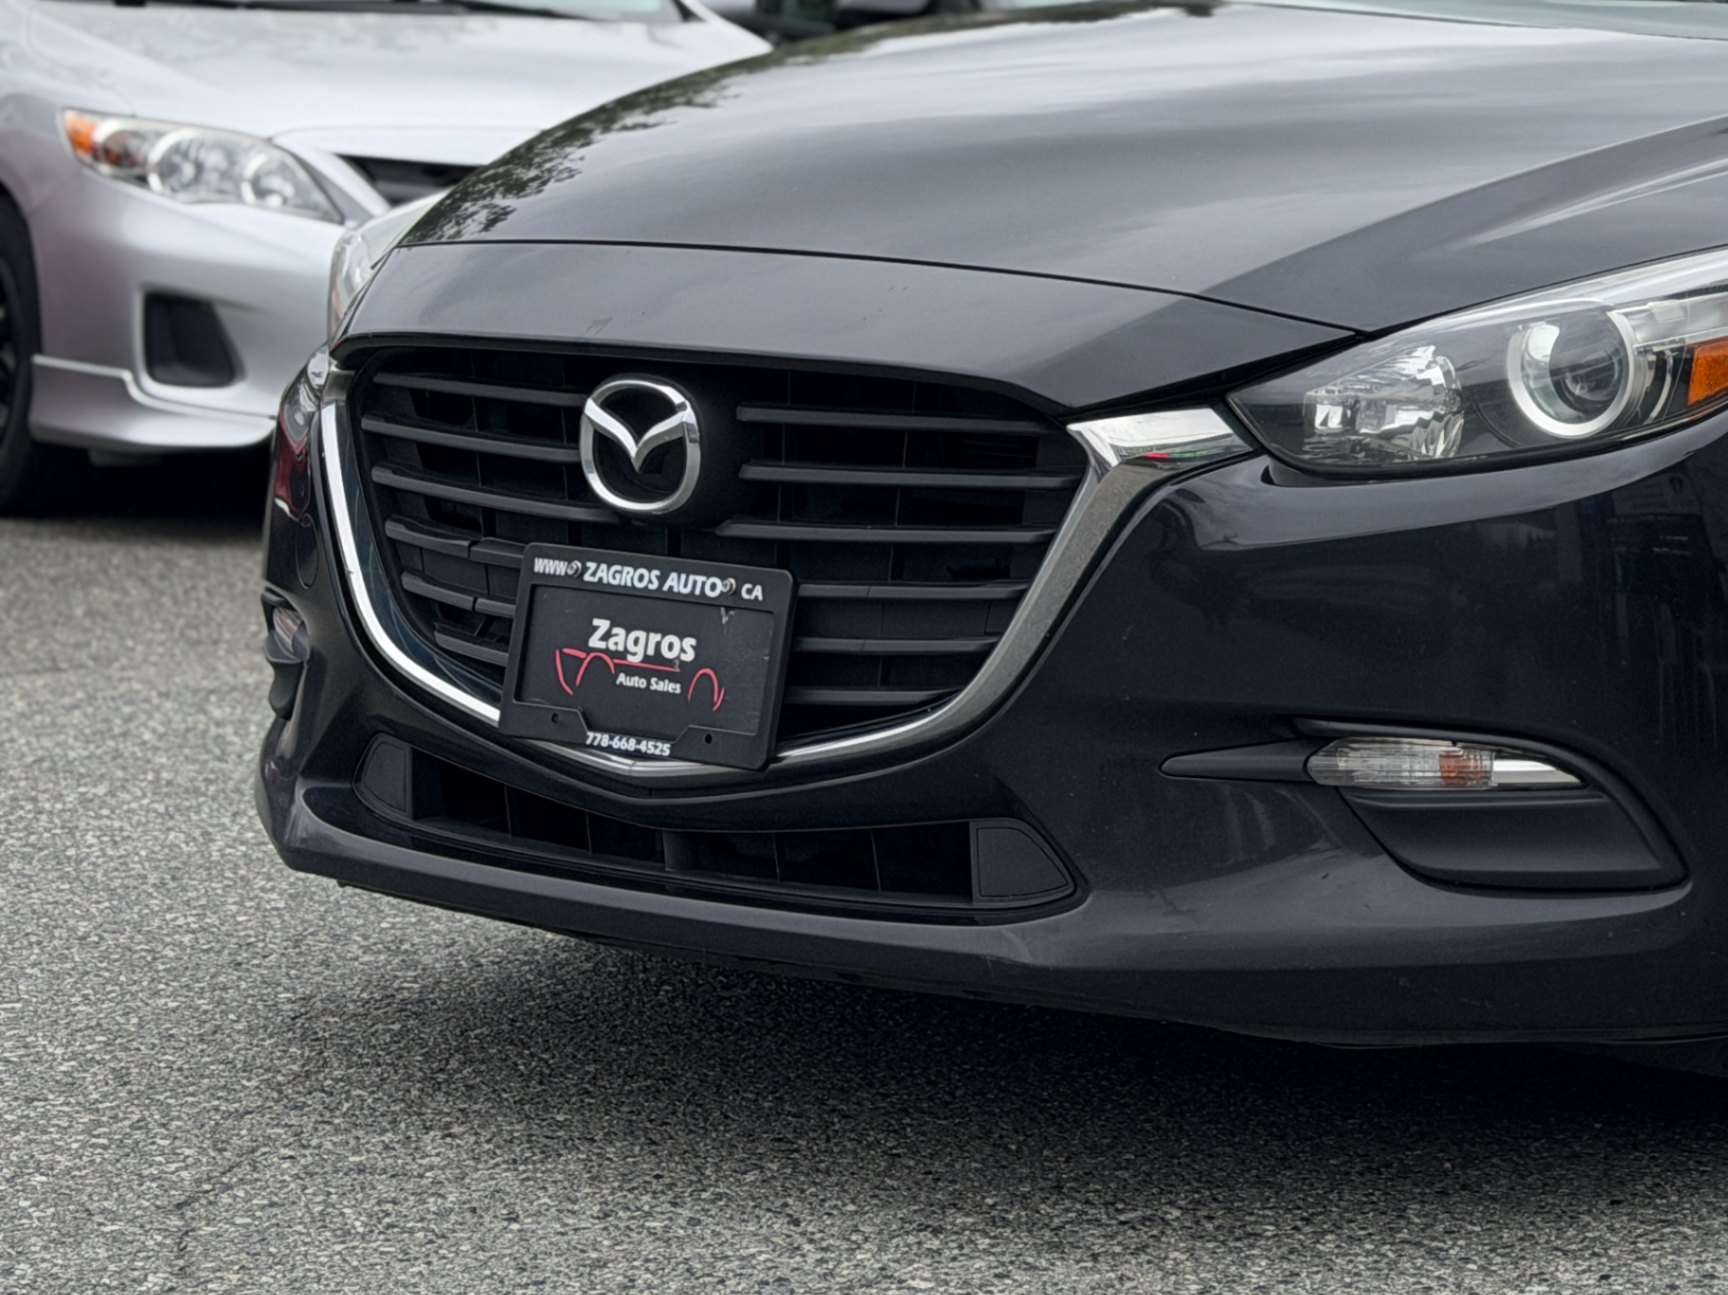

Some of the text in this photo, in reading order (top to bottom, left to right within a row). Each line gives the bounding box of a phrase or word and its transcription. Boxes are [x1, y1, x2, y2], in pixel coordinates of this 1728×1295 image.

[583, 561, 661, 590] ZAGROS
[662, 572, 721, 598] AUTO
[741, 583, 763, 601] CA
[588, 618, 697, 663] Zagros
[616, 672, 681, 694] Auto Sales
[585, 732, 672, 757] 778-668-4525
